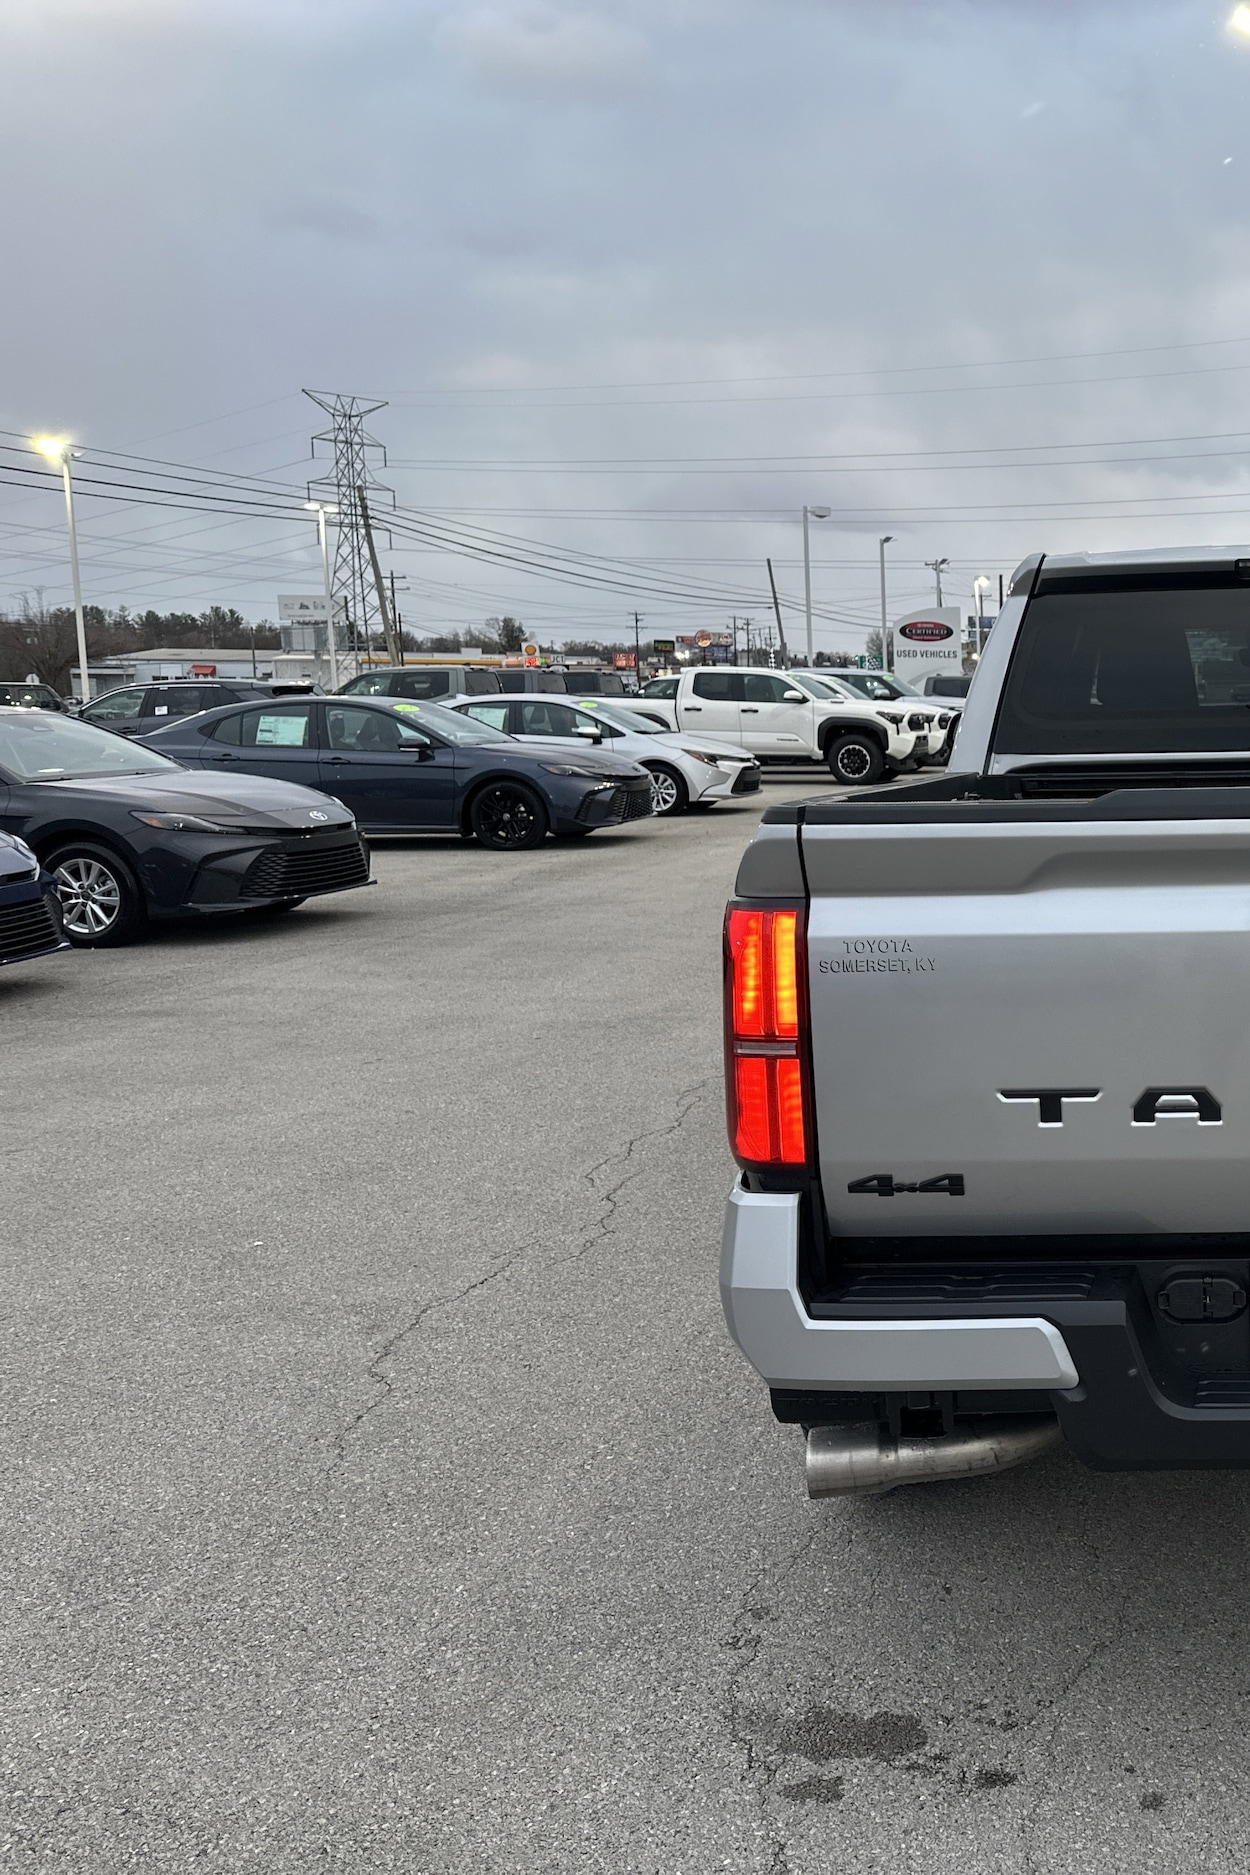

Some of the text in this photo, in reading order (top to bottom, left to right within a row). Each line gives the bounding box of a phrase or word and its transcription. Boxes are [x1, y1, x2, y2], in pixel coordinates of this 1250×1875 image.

[896, 649, 958, 659] USED VEHICLES
[843, 939, 913, 954] TOYOTA
[819, 957, 936, 974] SOMERSET, KY
